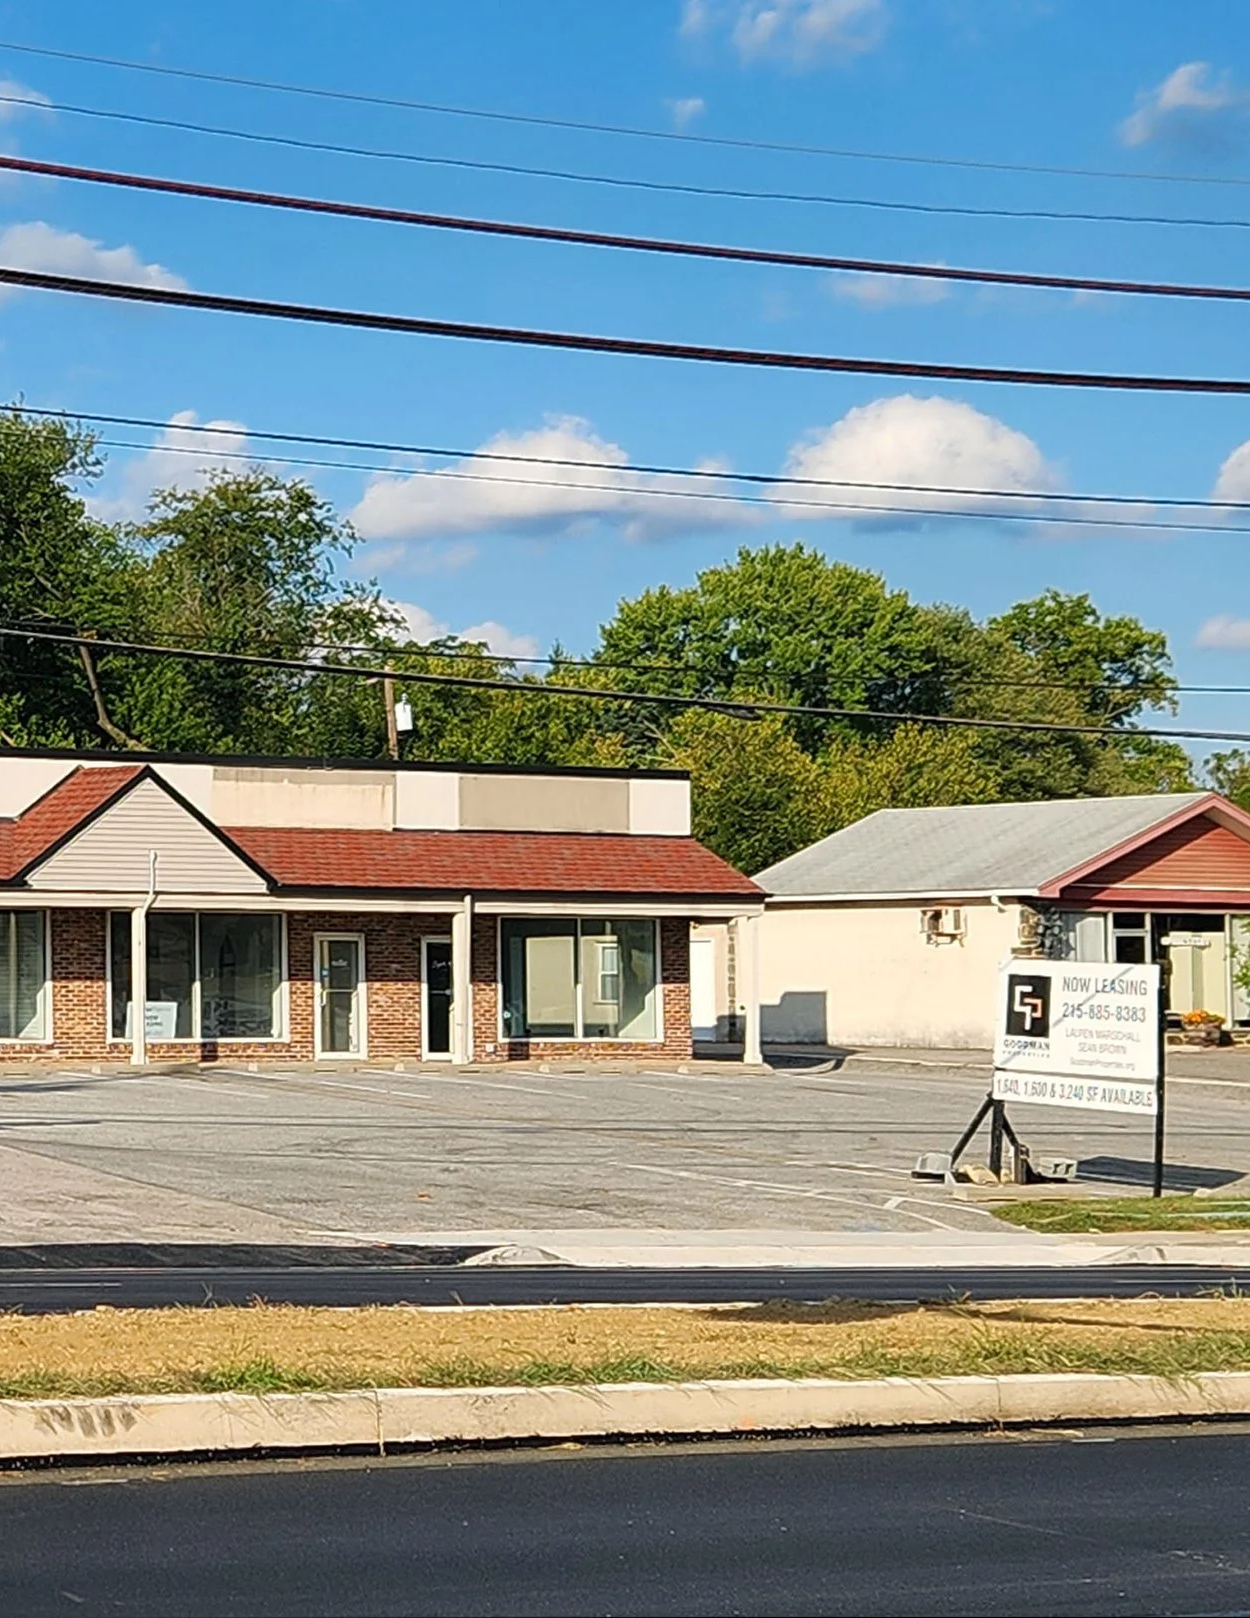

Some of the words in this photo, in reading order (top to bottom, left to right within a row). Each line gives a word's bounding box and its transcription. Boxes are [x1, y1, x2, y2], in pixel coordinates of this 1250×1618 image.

[1062, 976, 1091, 992] NOW
[1095, 977, 1148, 996] LEASING
[1062, 1002, 1146, 1023] 215-885-8383
[1086, 1086, 1099, 1102] SF
[1100, 1087, 1153, 1108] AVAILABLE
